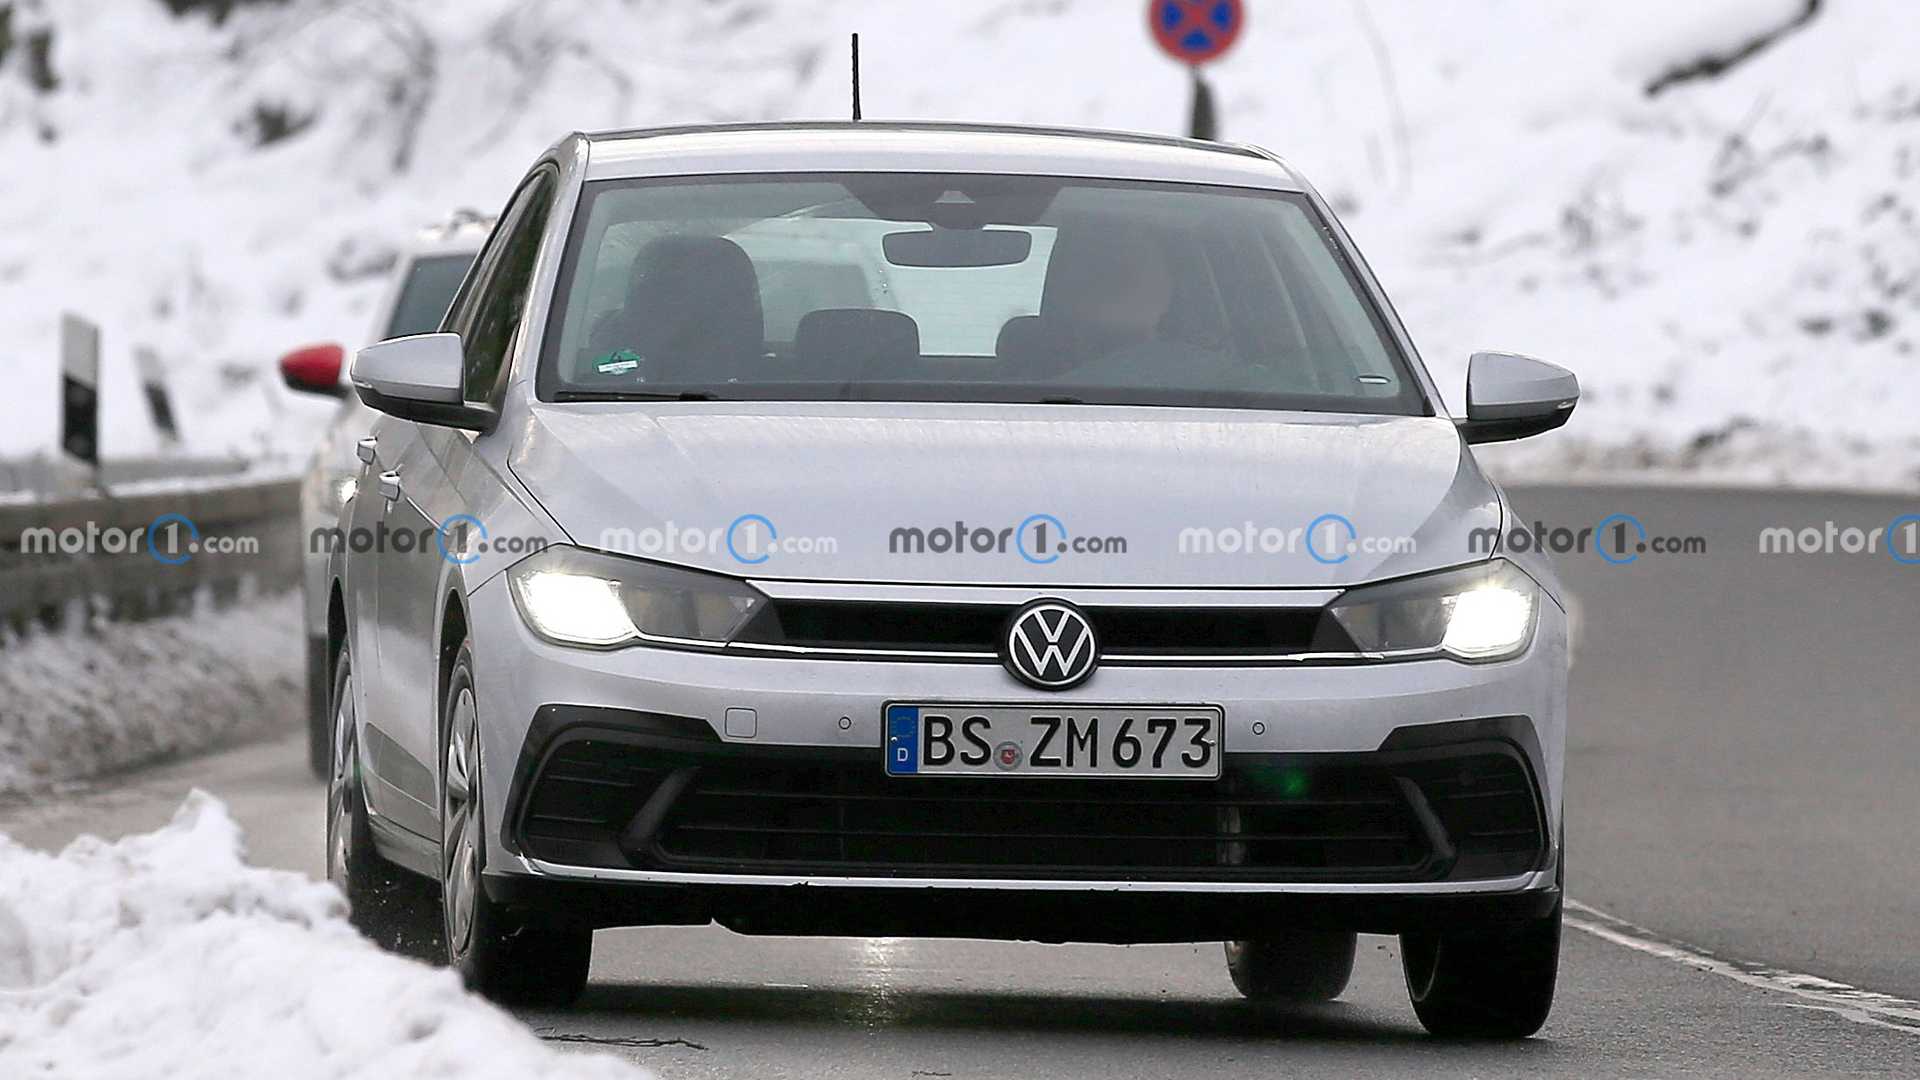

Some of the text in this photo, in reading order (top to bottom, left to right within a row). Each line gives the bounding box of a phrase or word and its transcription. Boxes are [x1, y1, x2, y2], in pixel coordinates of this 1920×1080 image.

[897, 748, 909, 762] D
[923, 716, 1212, 768] BS ZM 673
